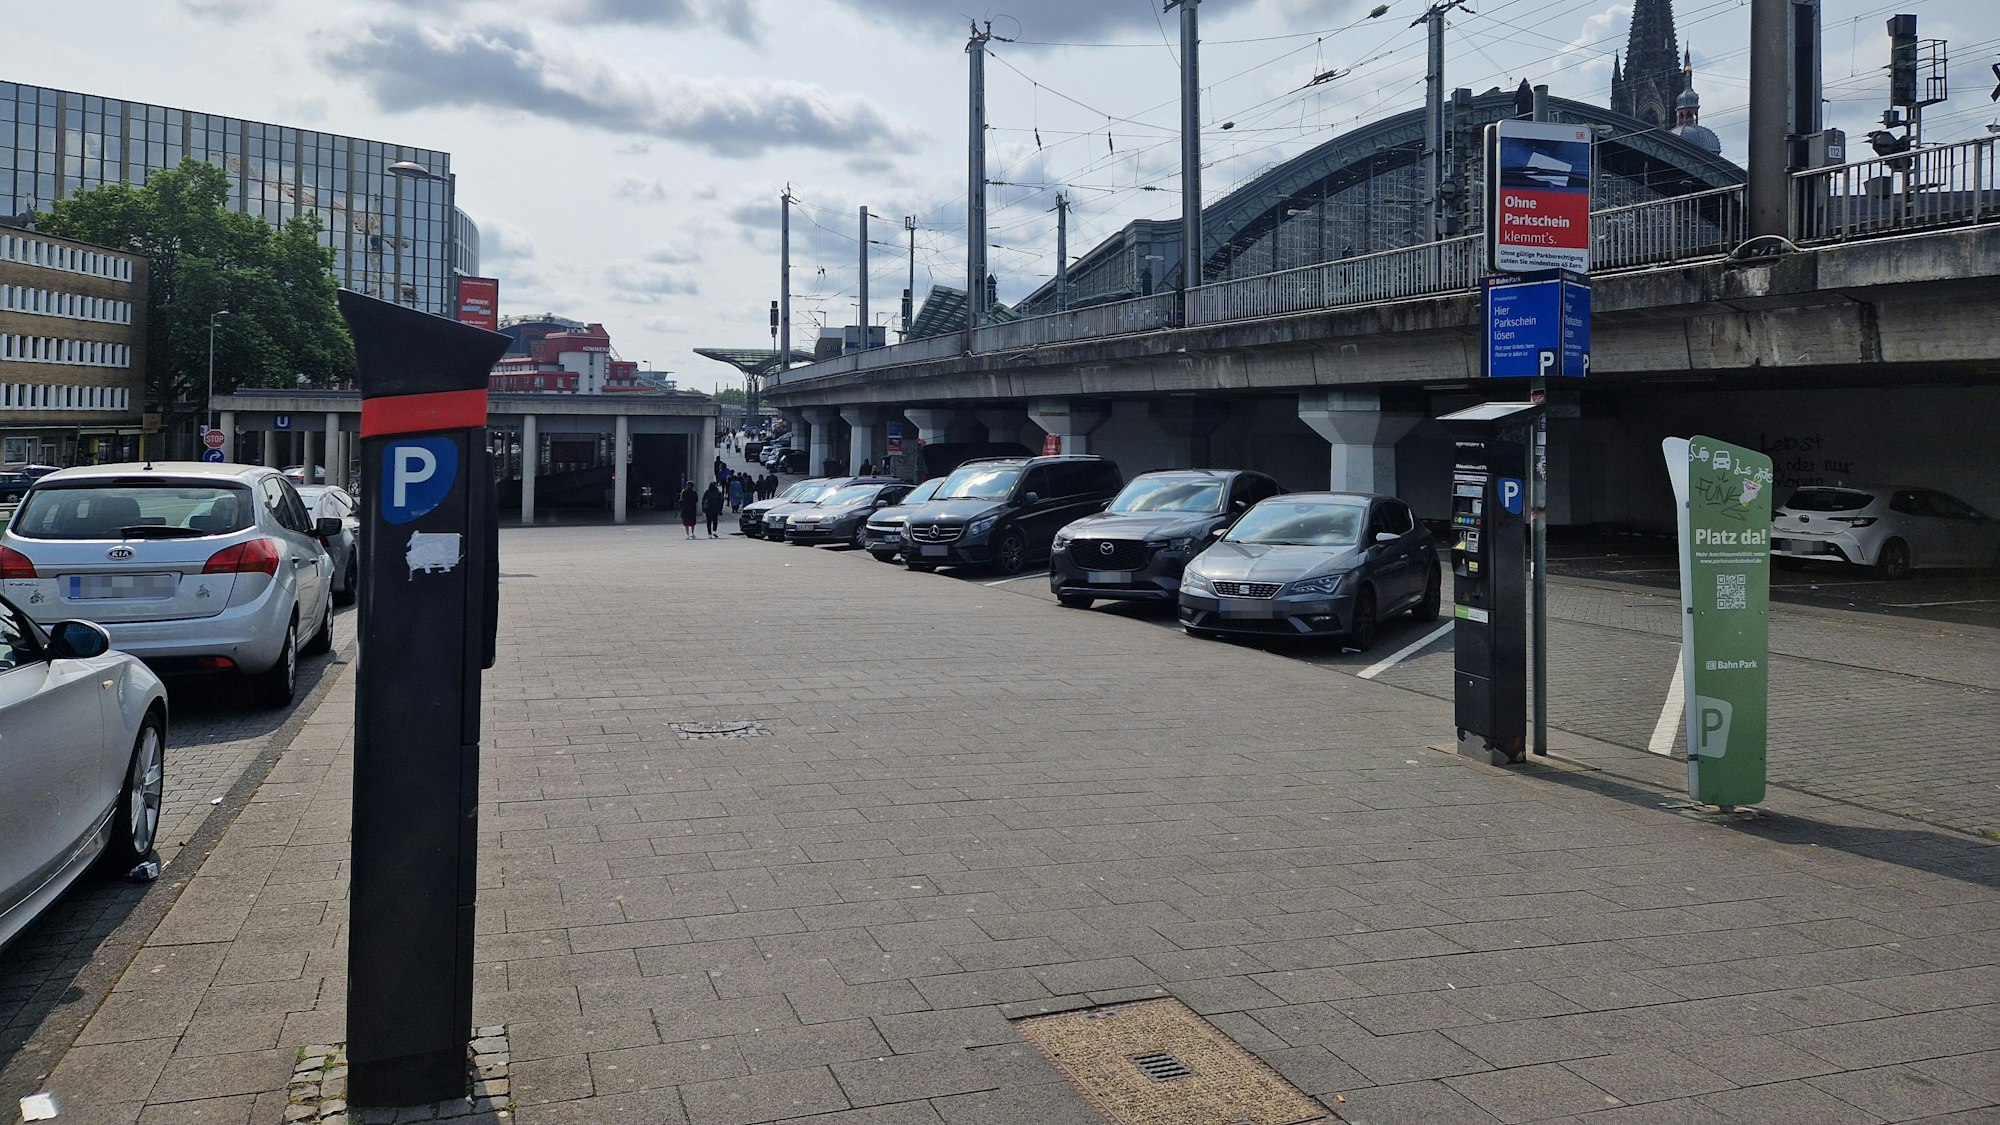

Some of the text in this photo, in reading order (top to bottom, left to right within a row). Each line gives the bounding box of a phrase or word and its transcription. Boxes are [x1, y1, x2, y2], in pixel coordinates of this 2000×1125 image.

[1830, 148, 1840, 156] 112
[1504, 195, 1537, 209] Ohne
[1504, 213, 1570, 228] Parkschein
[1536, 252, 1584, 262] Parkberechtigung
[1494, 306, 1510, 316] Hier
[1494, 316, 1536, 328] Parkschein
[1494, 330, 1515, 340] lösen
[1540, 351, 1554, 376] P
[1583, 354, 1589, 377] P
[277, 416, 289, 427] U
[394, 446, 436, 507] P
[1504, 481, 1518, 507] P
[1696, 529, 1766, 545] Platz da!
[1718, 661, 1738, 669] Bahn
[1739, 660, 1757, 668] Park
[1702, 709, 1723, 747] P
